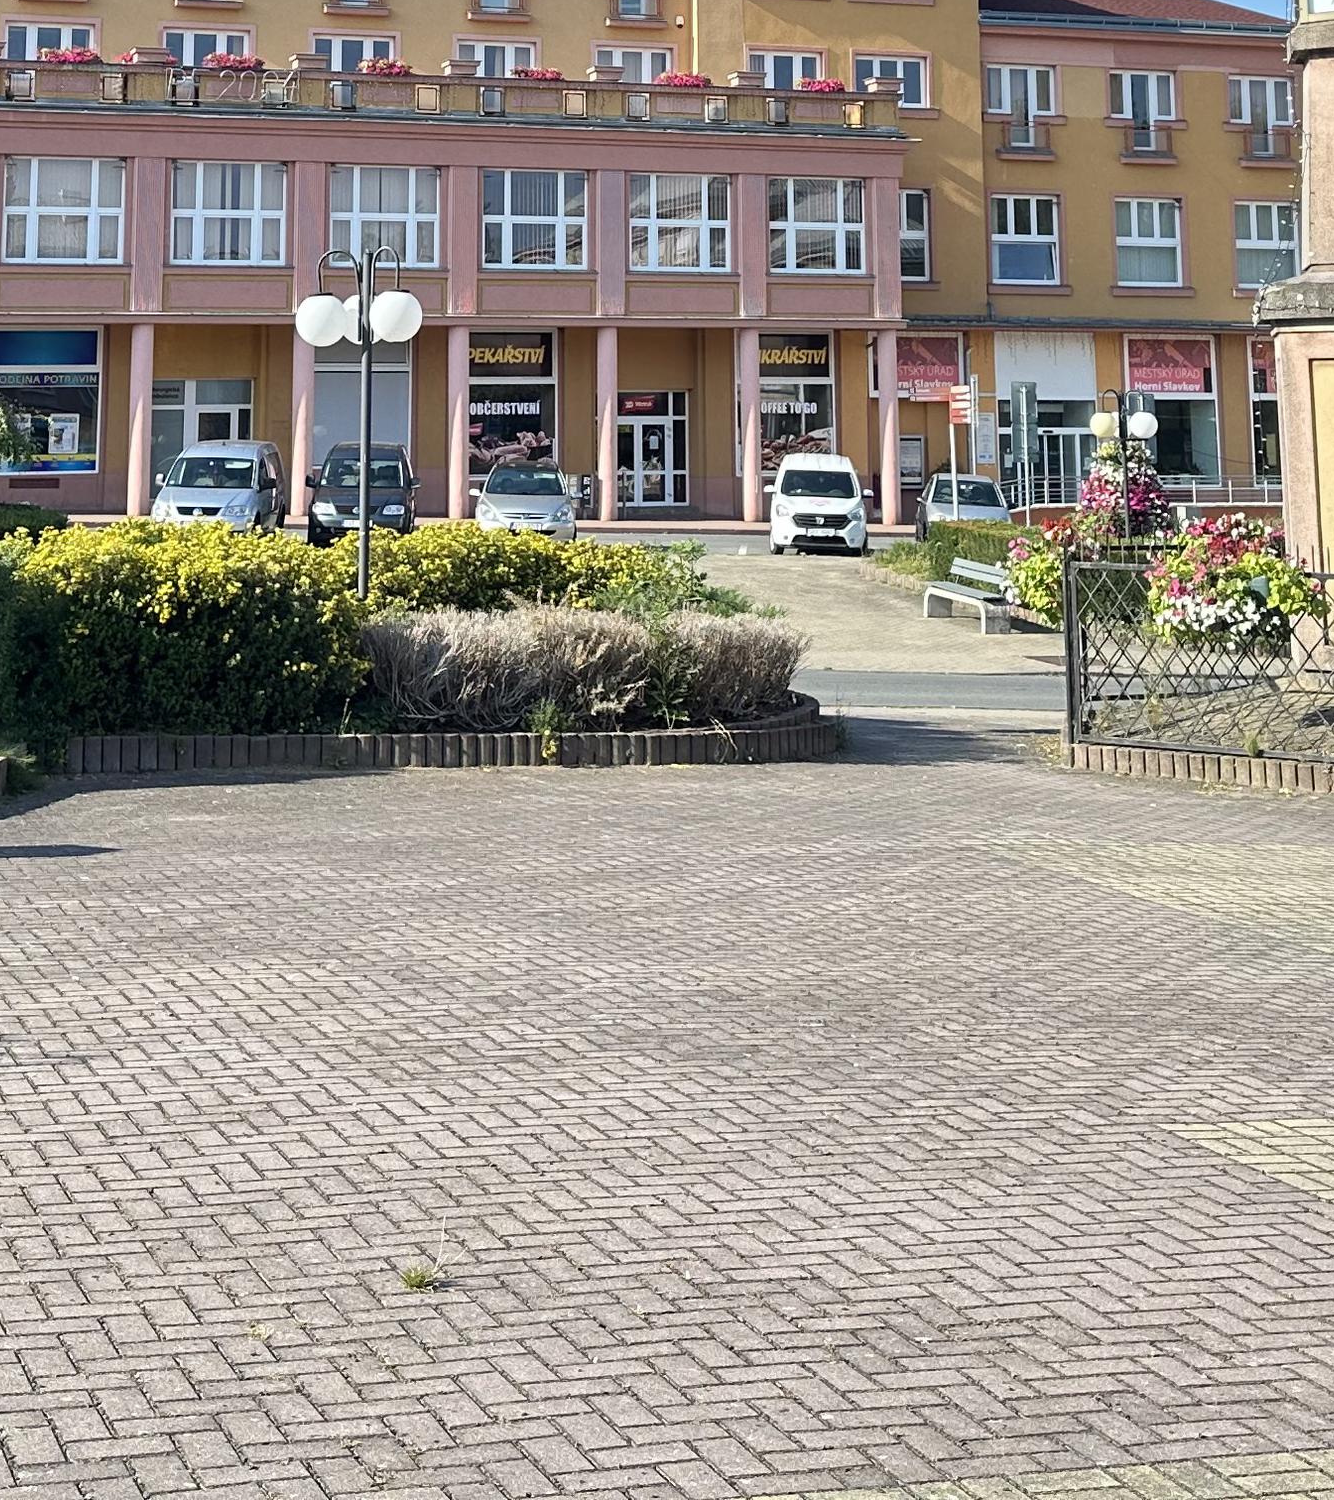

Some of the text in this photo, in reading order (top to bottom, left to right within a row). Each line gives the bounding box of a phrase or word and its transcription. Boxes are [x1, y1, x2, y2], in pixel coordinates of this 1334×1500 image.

[469, 344, 546, 364] PEKAŘSTVÍ
[759, 345, 827, 365] KRÁŘSTVÍ
[43, 374, 97, 384] POTRAVIN
[1134, 381, 1201, 392] Horní Slavkov
[469, 399, 541, 415] OBČERSTVENÍ
[760, 402, 818, 414] OFFEE TO GO
